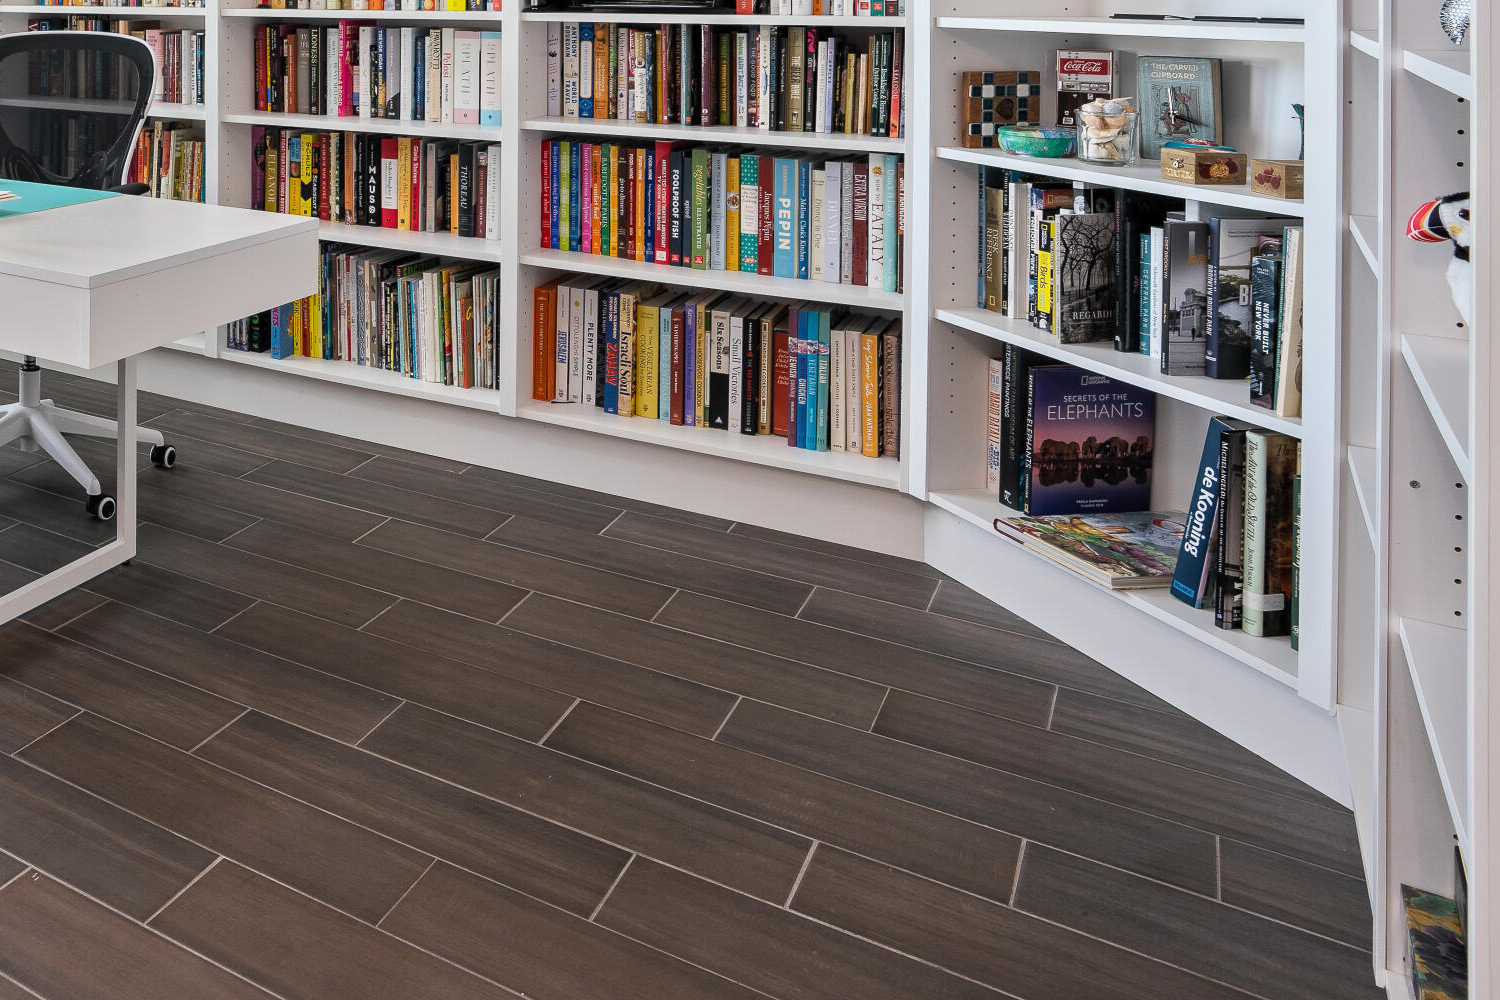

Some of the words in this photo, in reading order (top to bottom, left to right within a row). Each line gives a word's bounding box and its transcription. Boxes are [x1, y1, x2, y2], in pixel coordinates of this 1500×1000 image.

[442, 52, 452, 78] Pelosi
[486, 52, 495, 94] PLATH
[791, 56, 800, 66] THE
[1063, 61, 1102, 72] Coca-Cola
[790, 67, 800, 84] BEER
[790, 84, 800, 100] BIBLE
[460, 166, 468, 208] THOREAU
[694, 164, 705, 206] vegetables
[854, 174, 866, 196] EXTRA
[764, 192, 772, 220] Jacques
[854, 198, 866, 220] VIRGIN
[778, 198, 791, 250] PEPIN
[828, 200, 838, 244] DINNER
[872, 202, 884, 266] EATALY
[1039, 265, 1048, 289] Birds
[1262, 302, 1270, 328] NEVER
[716, 322, 724, 335] Six
[557, 330, 567, 364] JERUSALEM
[620, 331, 632, 367] Israeli
[716, 338, 724, 370] Seasons
[732, 338, 742, 363] Small
[606, 342, 618, 386] ZAHAV
[789, 355, 797, 378] JEWISH
[820, 360, 828, 384] ITALIAN
[620, 368, 631, 396] Soul
[730, 366, 741, 404] Victories
[798, 378, 806, 404] CHICKEN
[808, 360, 816, 396] VEGETARIAN
[990, 392, 1000, 414] MARIO
[1047, 402, 1143, 420] ELEPHANTS
[989, 416, 1000, 442] BATALI
[1248, 440, 1258, 452] The
[1248, 451, 1258, 474] ART
[1202, 466, 1218, 487] de
[1184, 487, 1216, 558] Kooning
[1246, 512, 1256, 542] SOUTH
